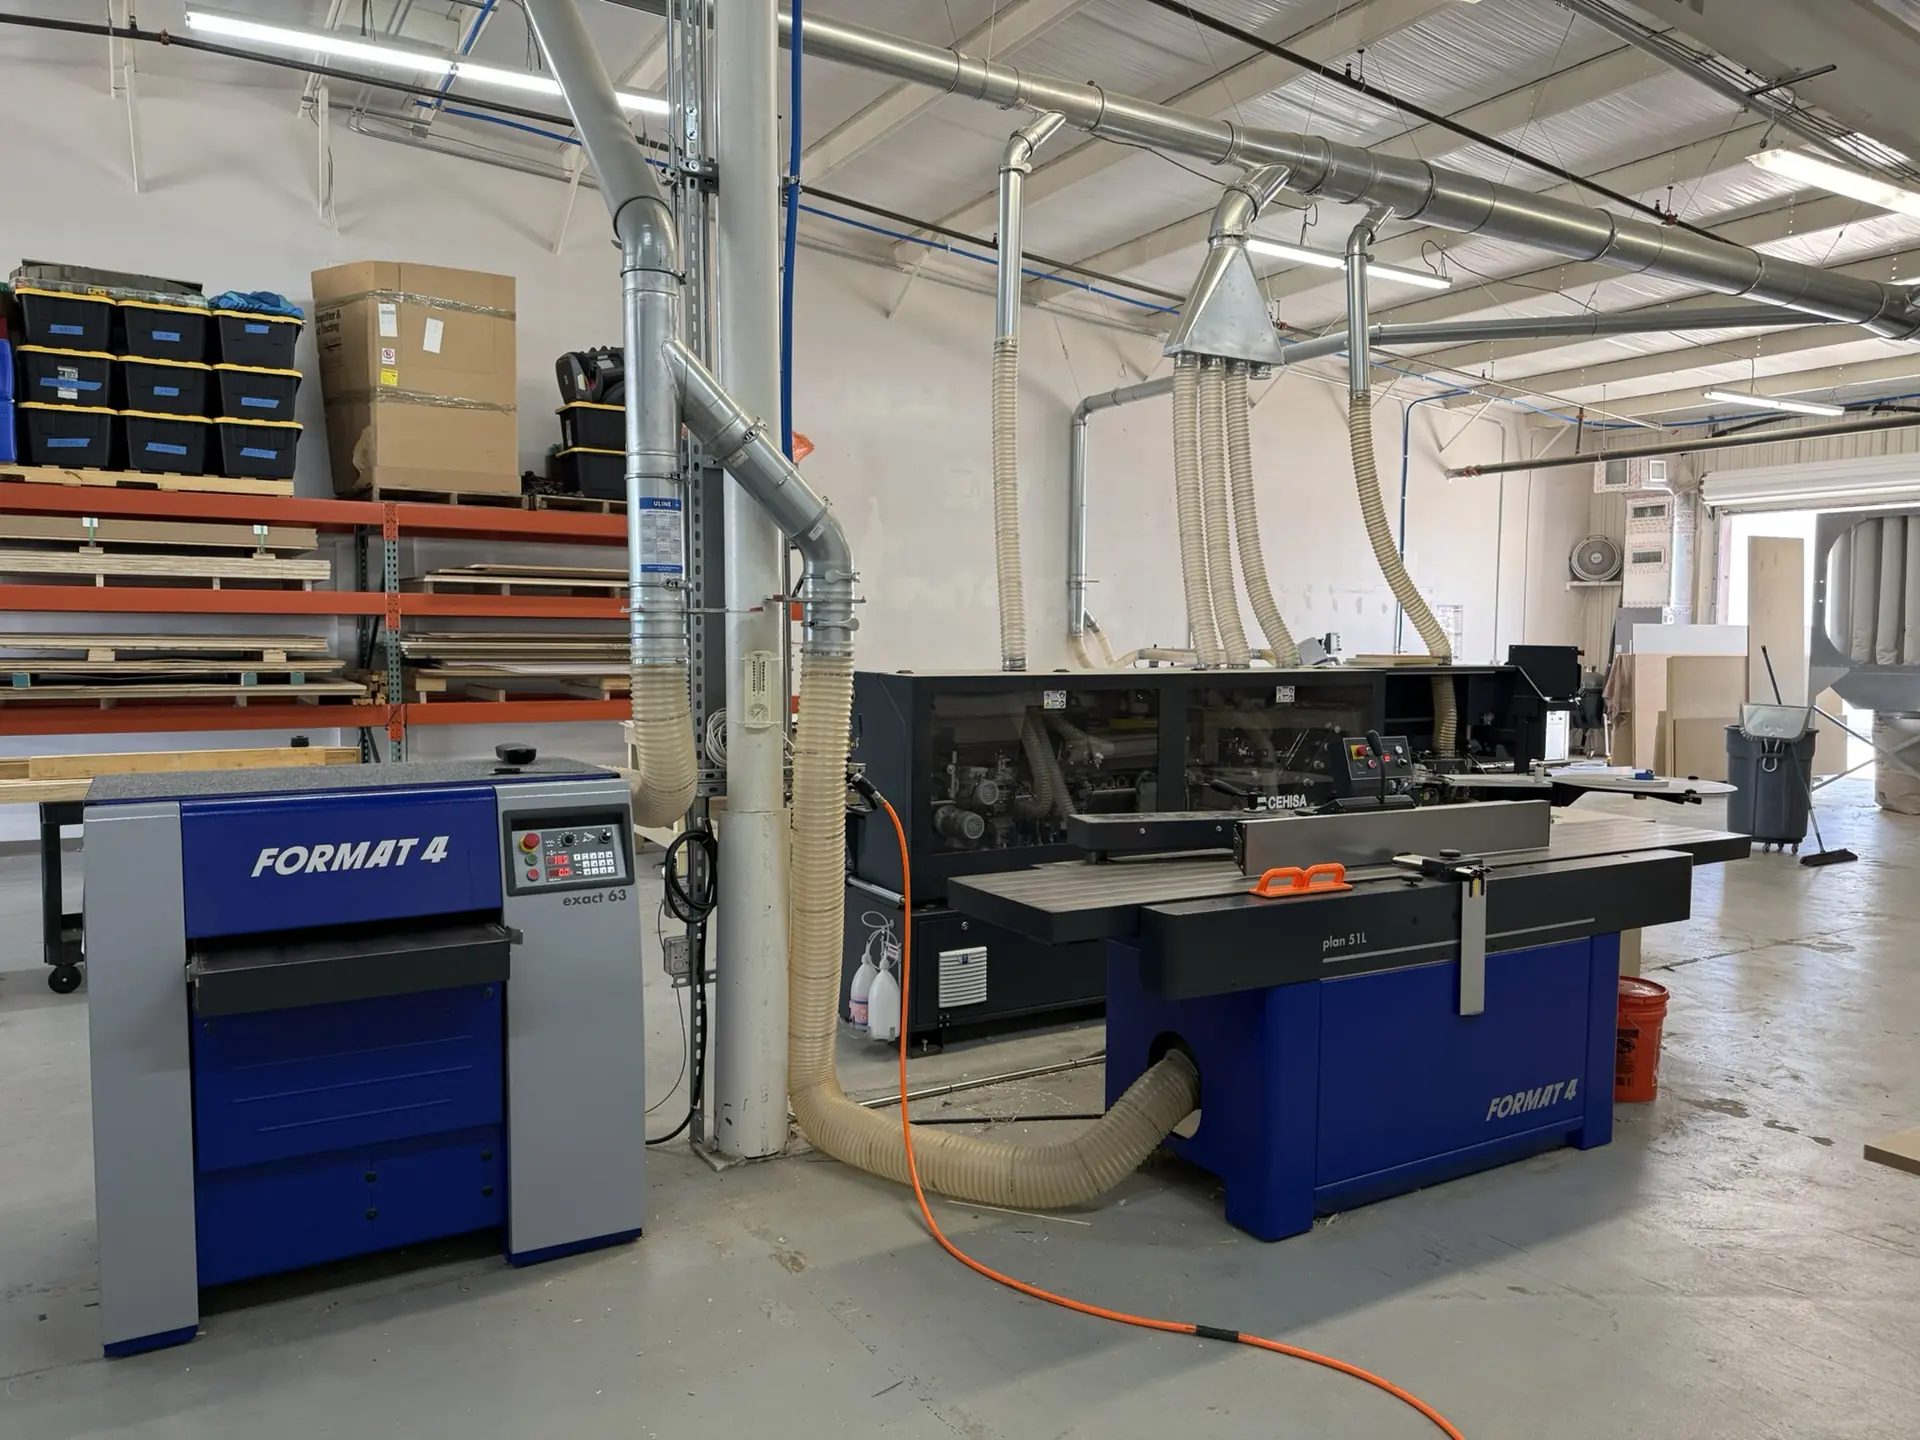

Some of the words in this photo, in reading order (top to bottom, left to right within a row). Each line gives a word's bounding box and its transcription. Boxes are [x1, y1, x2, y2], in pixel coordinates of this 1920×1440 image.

[1268, 794, 1308, 809] CEHISA
[251, 837, 420, 878] FORMAT
[420, 835, 450, 863] 4
[563, 891, 604, 906] exact
[608, 889, 627, 903] 63
[1323, 935, 1346, 952] plan
[1348, 932, 1367, 945] 51L
[1485, 1081, 1565, 1122] FORMAT
[1563, 1078, 1579, 1100] 4
